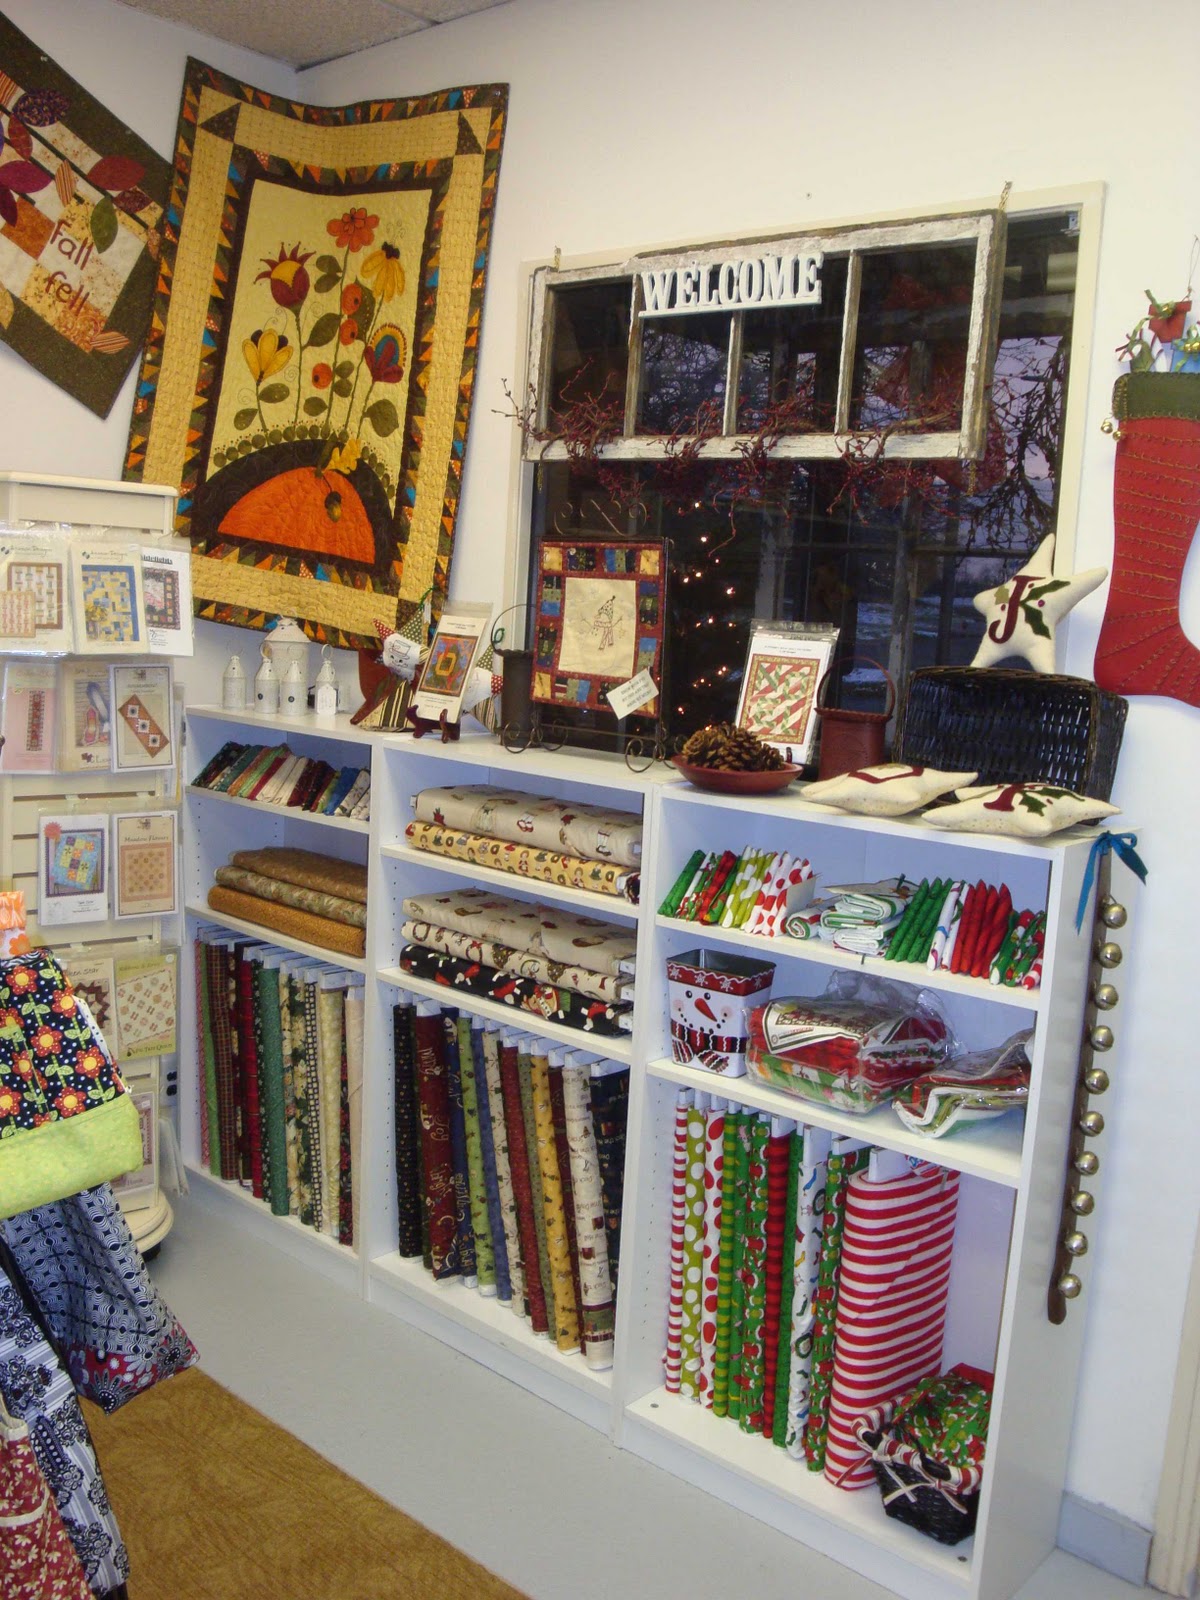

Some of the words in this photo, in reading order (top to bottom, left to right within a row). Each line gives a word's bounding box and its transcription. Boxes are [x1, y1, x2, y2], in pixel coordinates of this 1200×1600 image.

[50, 219, 94, 271] Fall
[45, 271, 90, 317] fell
[641, 253, 824, 312] WELCOME
